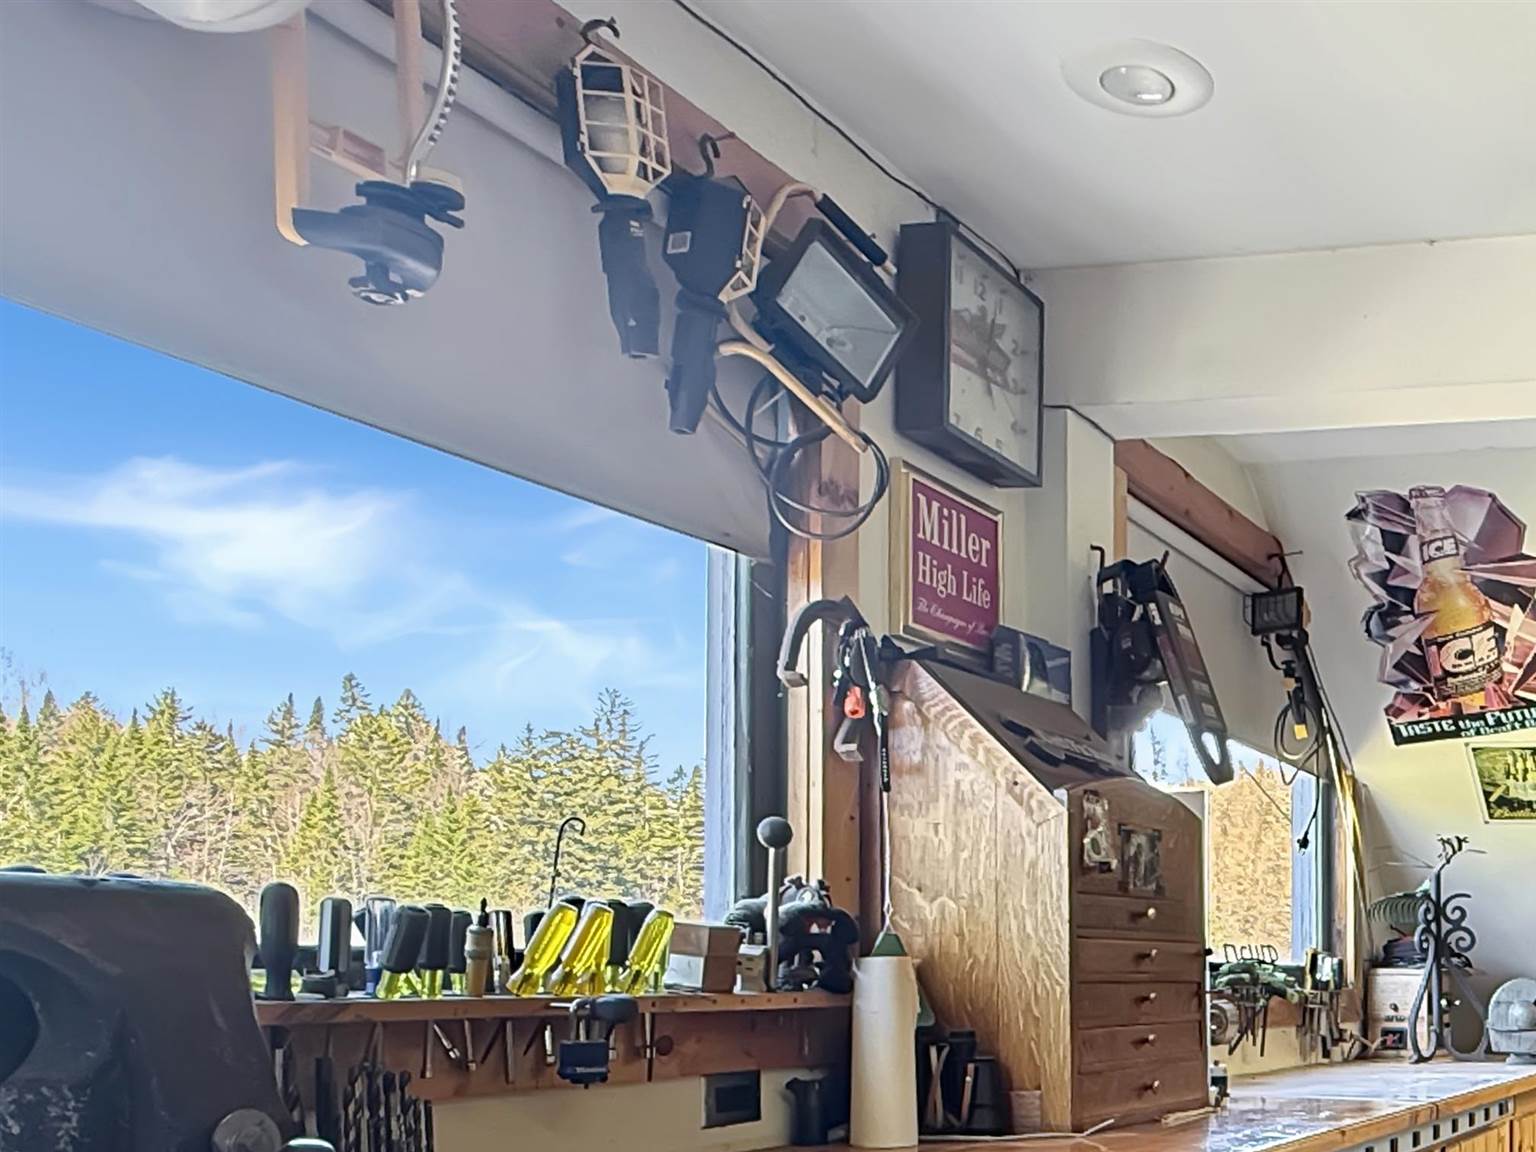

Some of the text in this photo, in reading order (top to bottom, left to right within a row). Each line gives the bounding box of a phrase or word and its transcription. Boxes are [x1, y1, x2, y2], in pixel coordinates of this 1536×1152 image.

[974, 277, 986, 302] 12
[917, 492, 991, 568] Miller
[1423, 537, 1458, 562] ICE
[917, 551, 991, 609] High Life
[1428, 626, 1500, 677] ICE
[1396, 718, 1456, 737] TASTE
